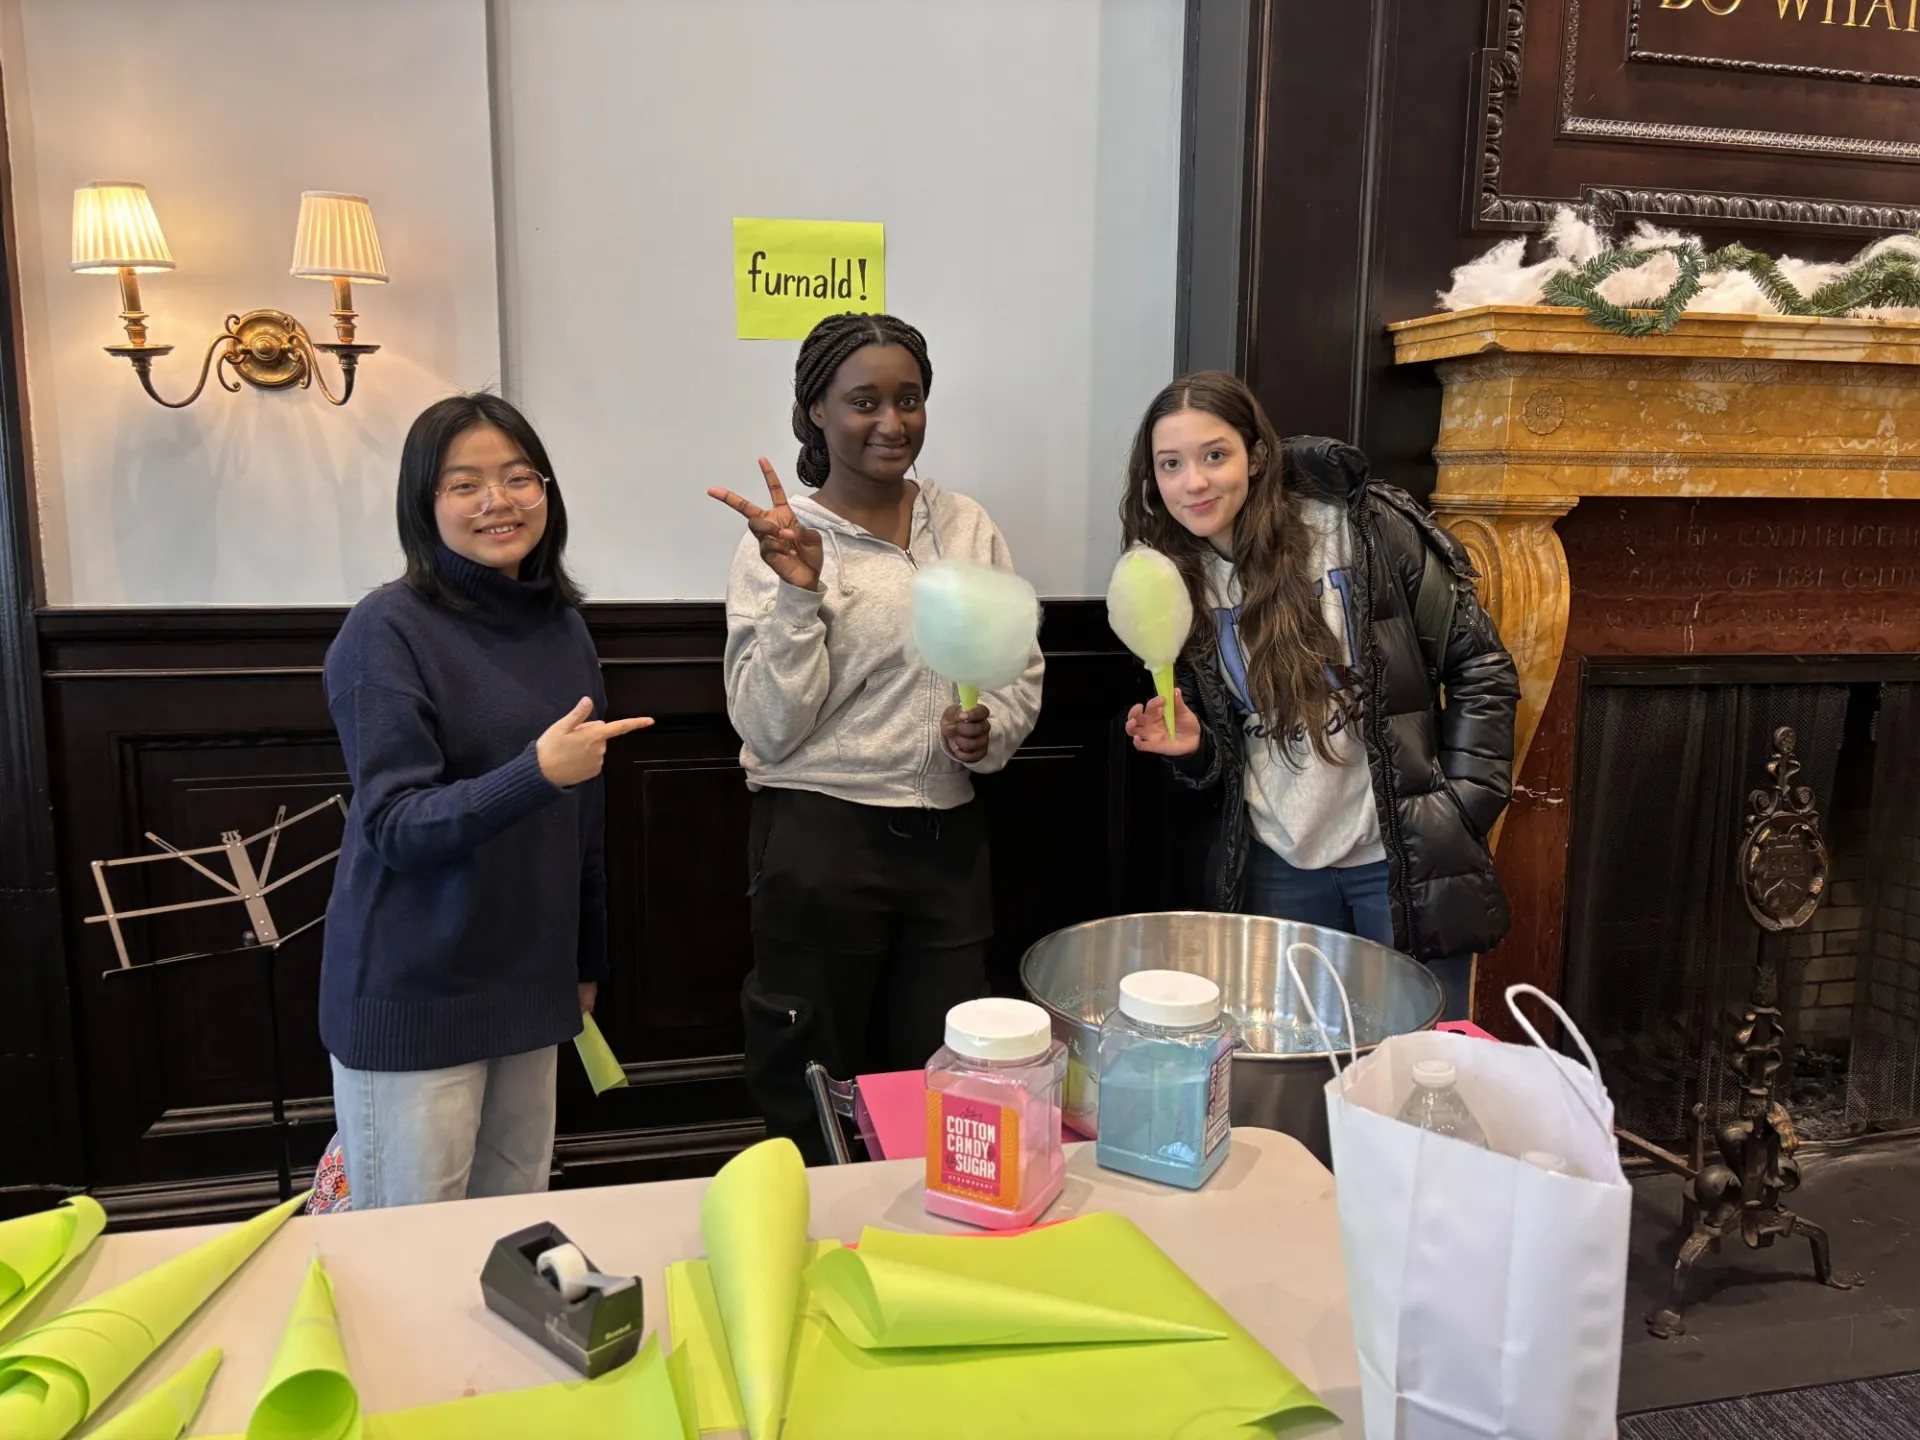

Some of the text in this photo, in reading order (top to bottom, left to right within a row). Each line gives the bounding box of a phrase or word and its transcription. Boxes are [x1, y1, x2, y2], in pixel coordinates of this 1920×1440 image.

[747, 250, 868, 301] furnald!
[1726, 566, 1758, 590] OF
[1775, 566, 1823, 589] 1881
[946, 1115, 996, 1144] COTTON
[947, 1133, 990, 1160] CANDY
[955, 1154, 996, 1181] SUGAR
